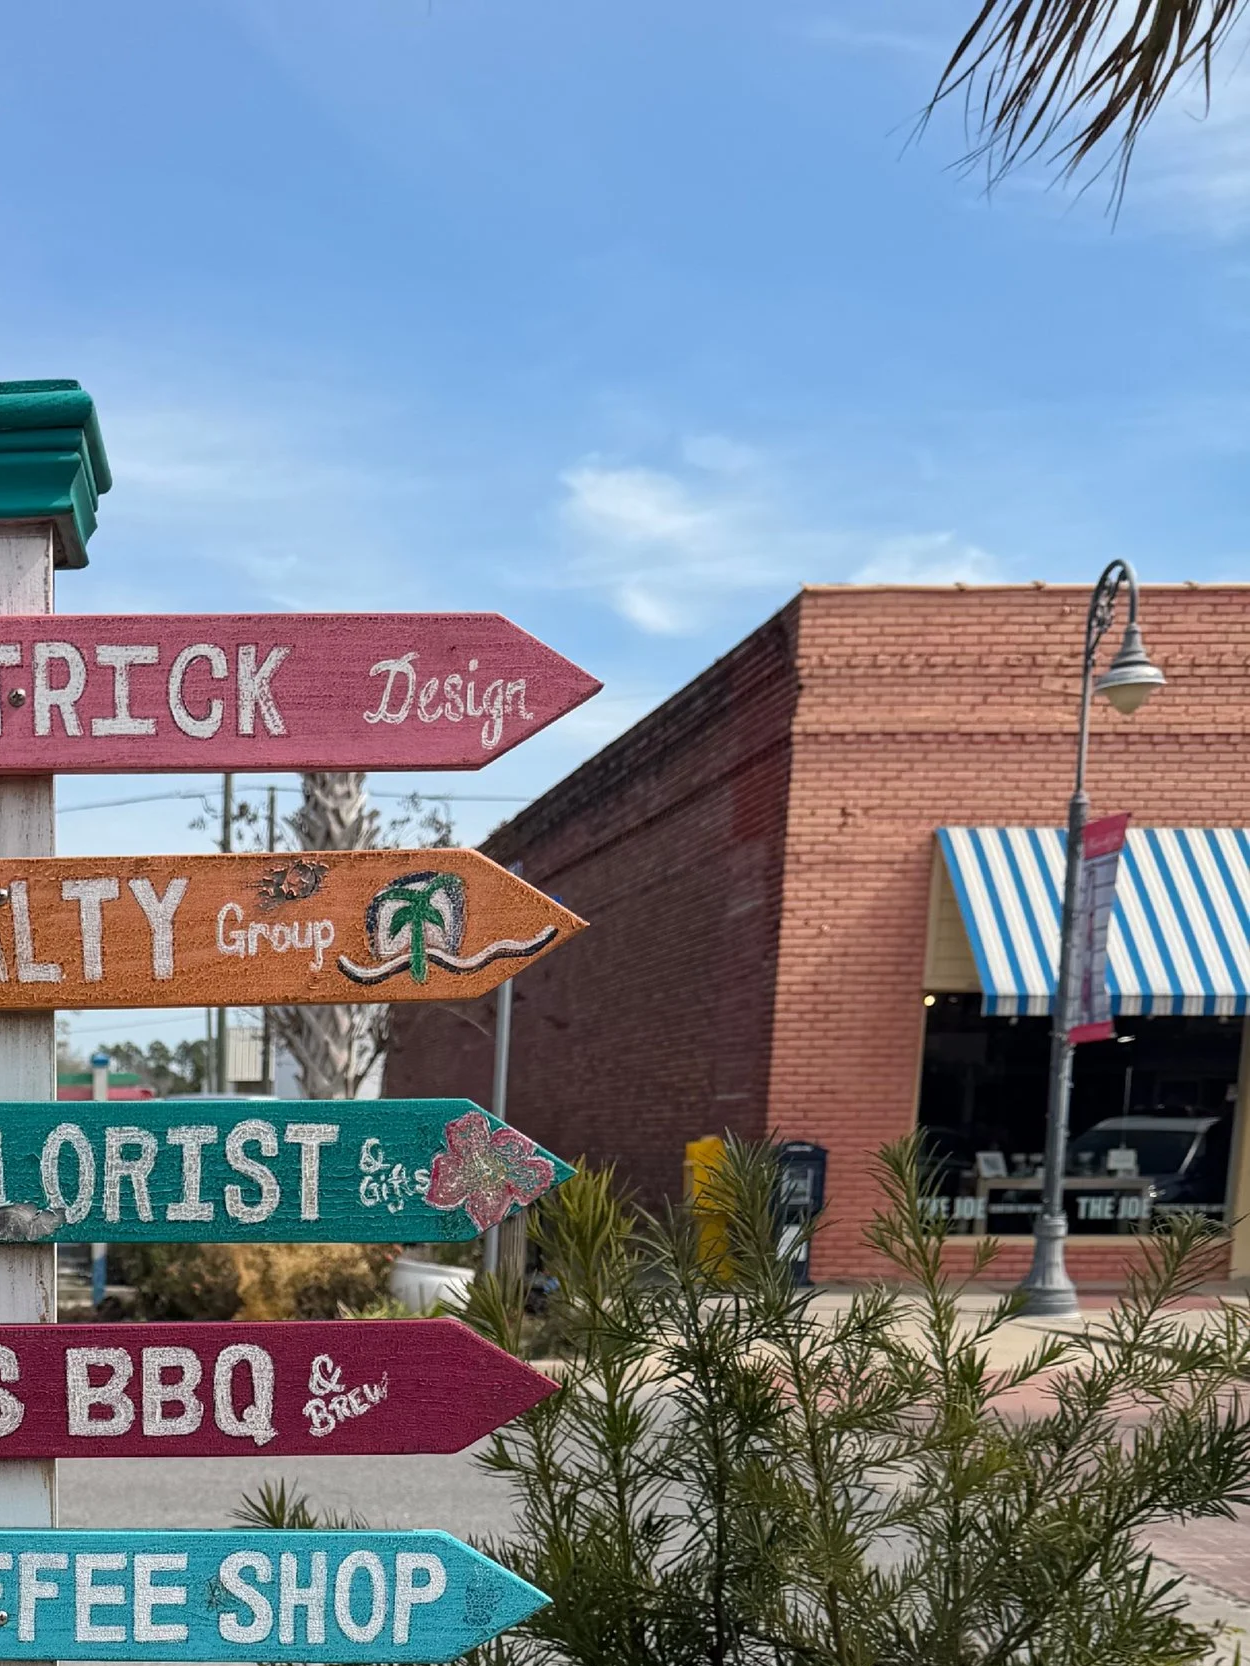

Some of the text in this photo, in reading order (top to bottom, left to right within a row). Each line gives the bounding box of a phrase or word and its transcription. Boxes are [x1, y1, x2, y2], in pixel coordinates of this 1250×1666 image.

[363, 651, 533, 749] Design
[216, 902, 335, 973] Group
[360, 1138, 390, 1173] &
[359, 1163, 430, 1213] Gifts
[953, 1197, 986, 1219] JOE
[1076, 1196, 1115, 1219] THE
[1117, 1196, 1150, 1219] JOE
[66, 1343, 278, 1447] BBQ
[302, 1371, 388, 1437] BREW
[309, 1354, 345, 1396] &
[218, 1550, 446, 1645] SHOP
